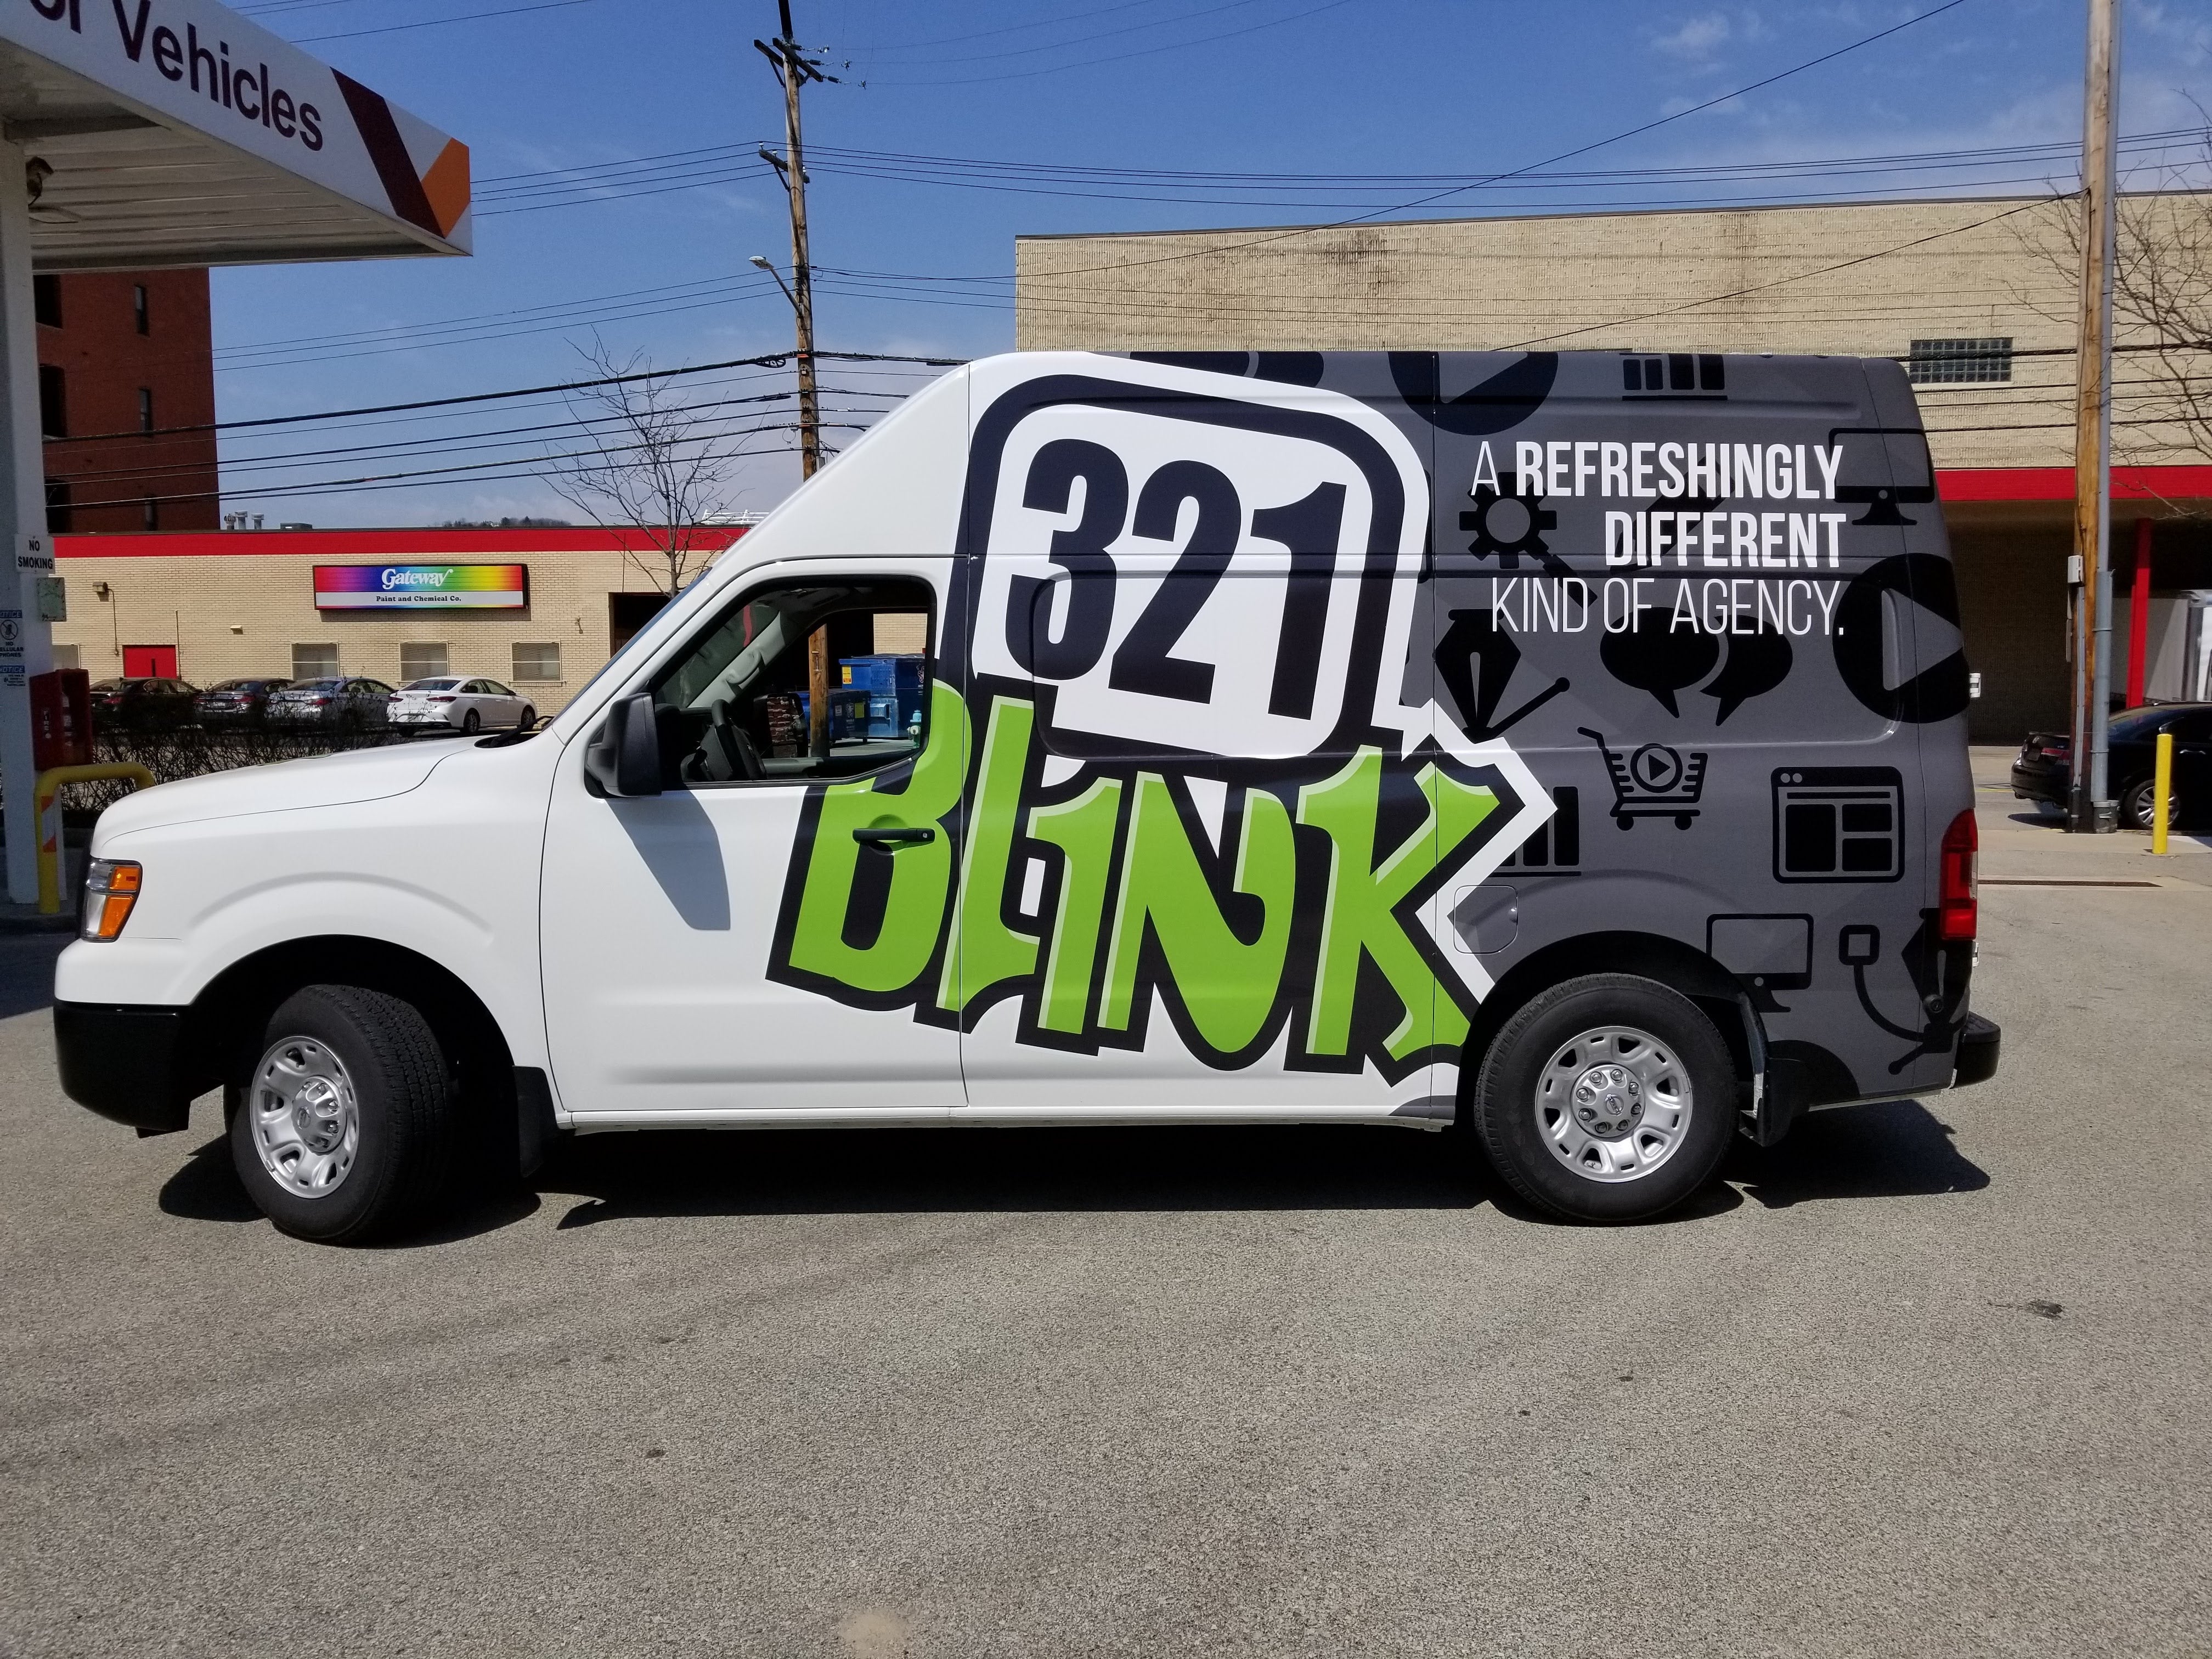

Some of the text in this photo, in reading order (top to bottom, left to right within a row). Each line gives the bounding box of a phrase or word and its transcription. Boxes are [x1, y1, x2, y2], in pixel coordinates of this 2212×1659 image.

[112, 0, 323, 151] Vehicles
[1471, 441, 1844, 500] A REFRESHINGLY
[18, 556, 53, 569] SMOKING
[29, 540, 40, 551] NO
[1605, 511, 1847, 568] DIFFERENT
[381, 568, 454, 590] Gateway
[1005, 438, 1347, 720] 321
[1492, 577, 1844, 636] KIND OF AGENCY.
